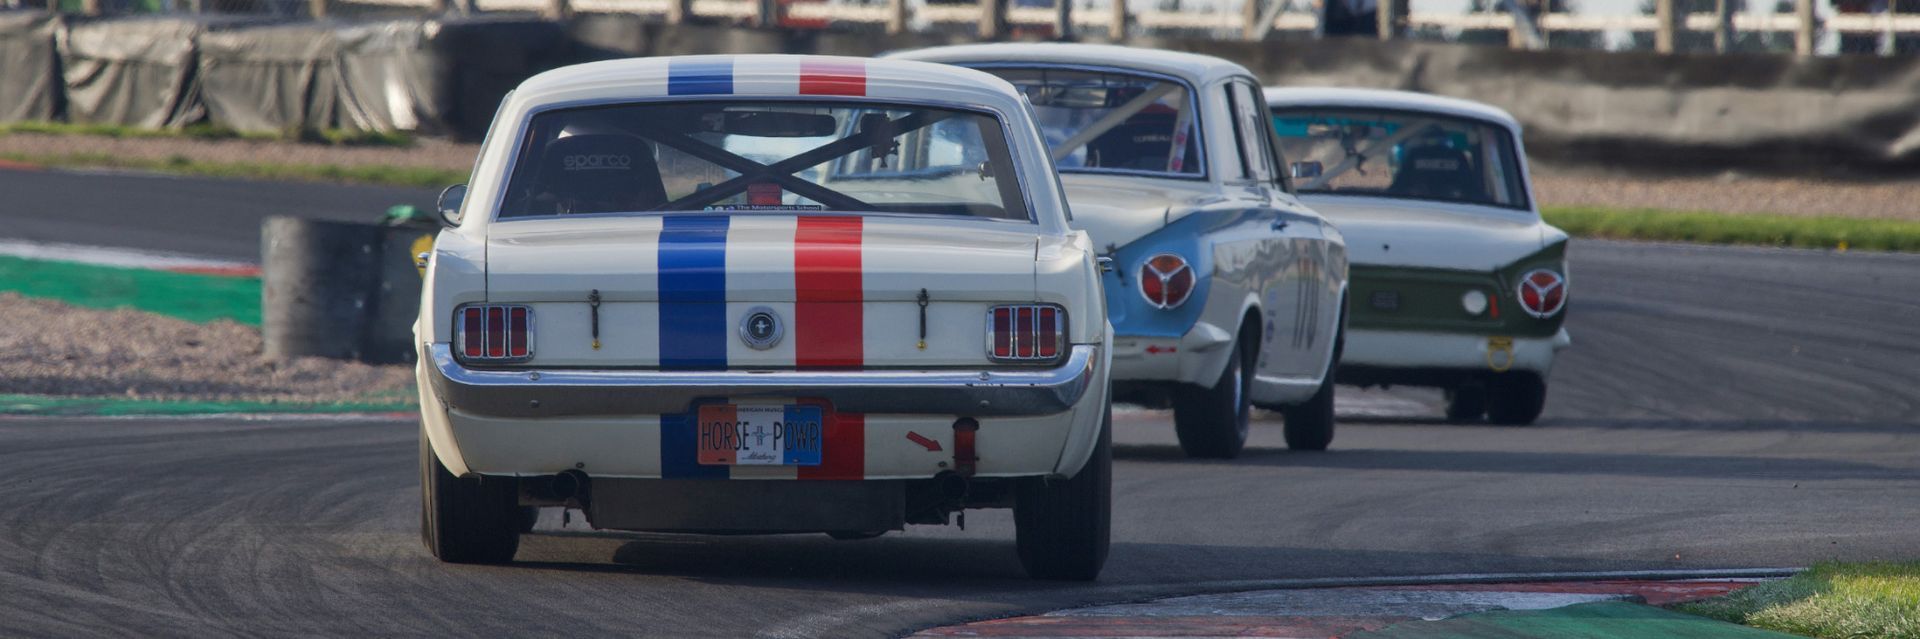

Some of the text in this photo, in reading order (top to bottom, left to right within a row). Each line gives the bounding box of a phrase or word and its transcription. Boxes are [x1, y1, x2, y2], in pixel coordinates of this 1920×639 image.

[563, 154, 631, 171] sparco
[701, 421, 819, 451] HORSE POWR
